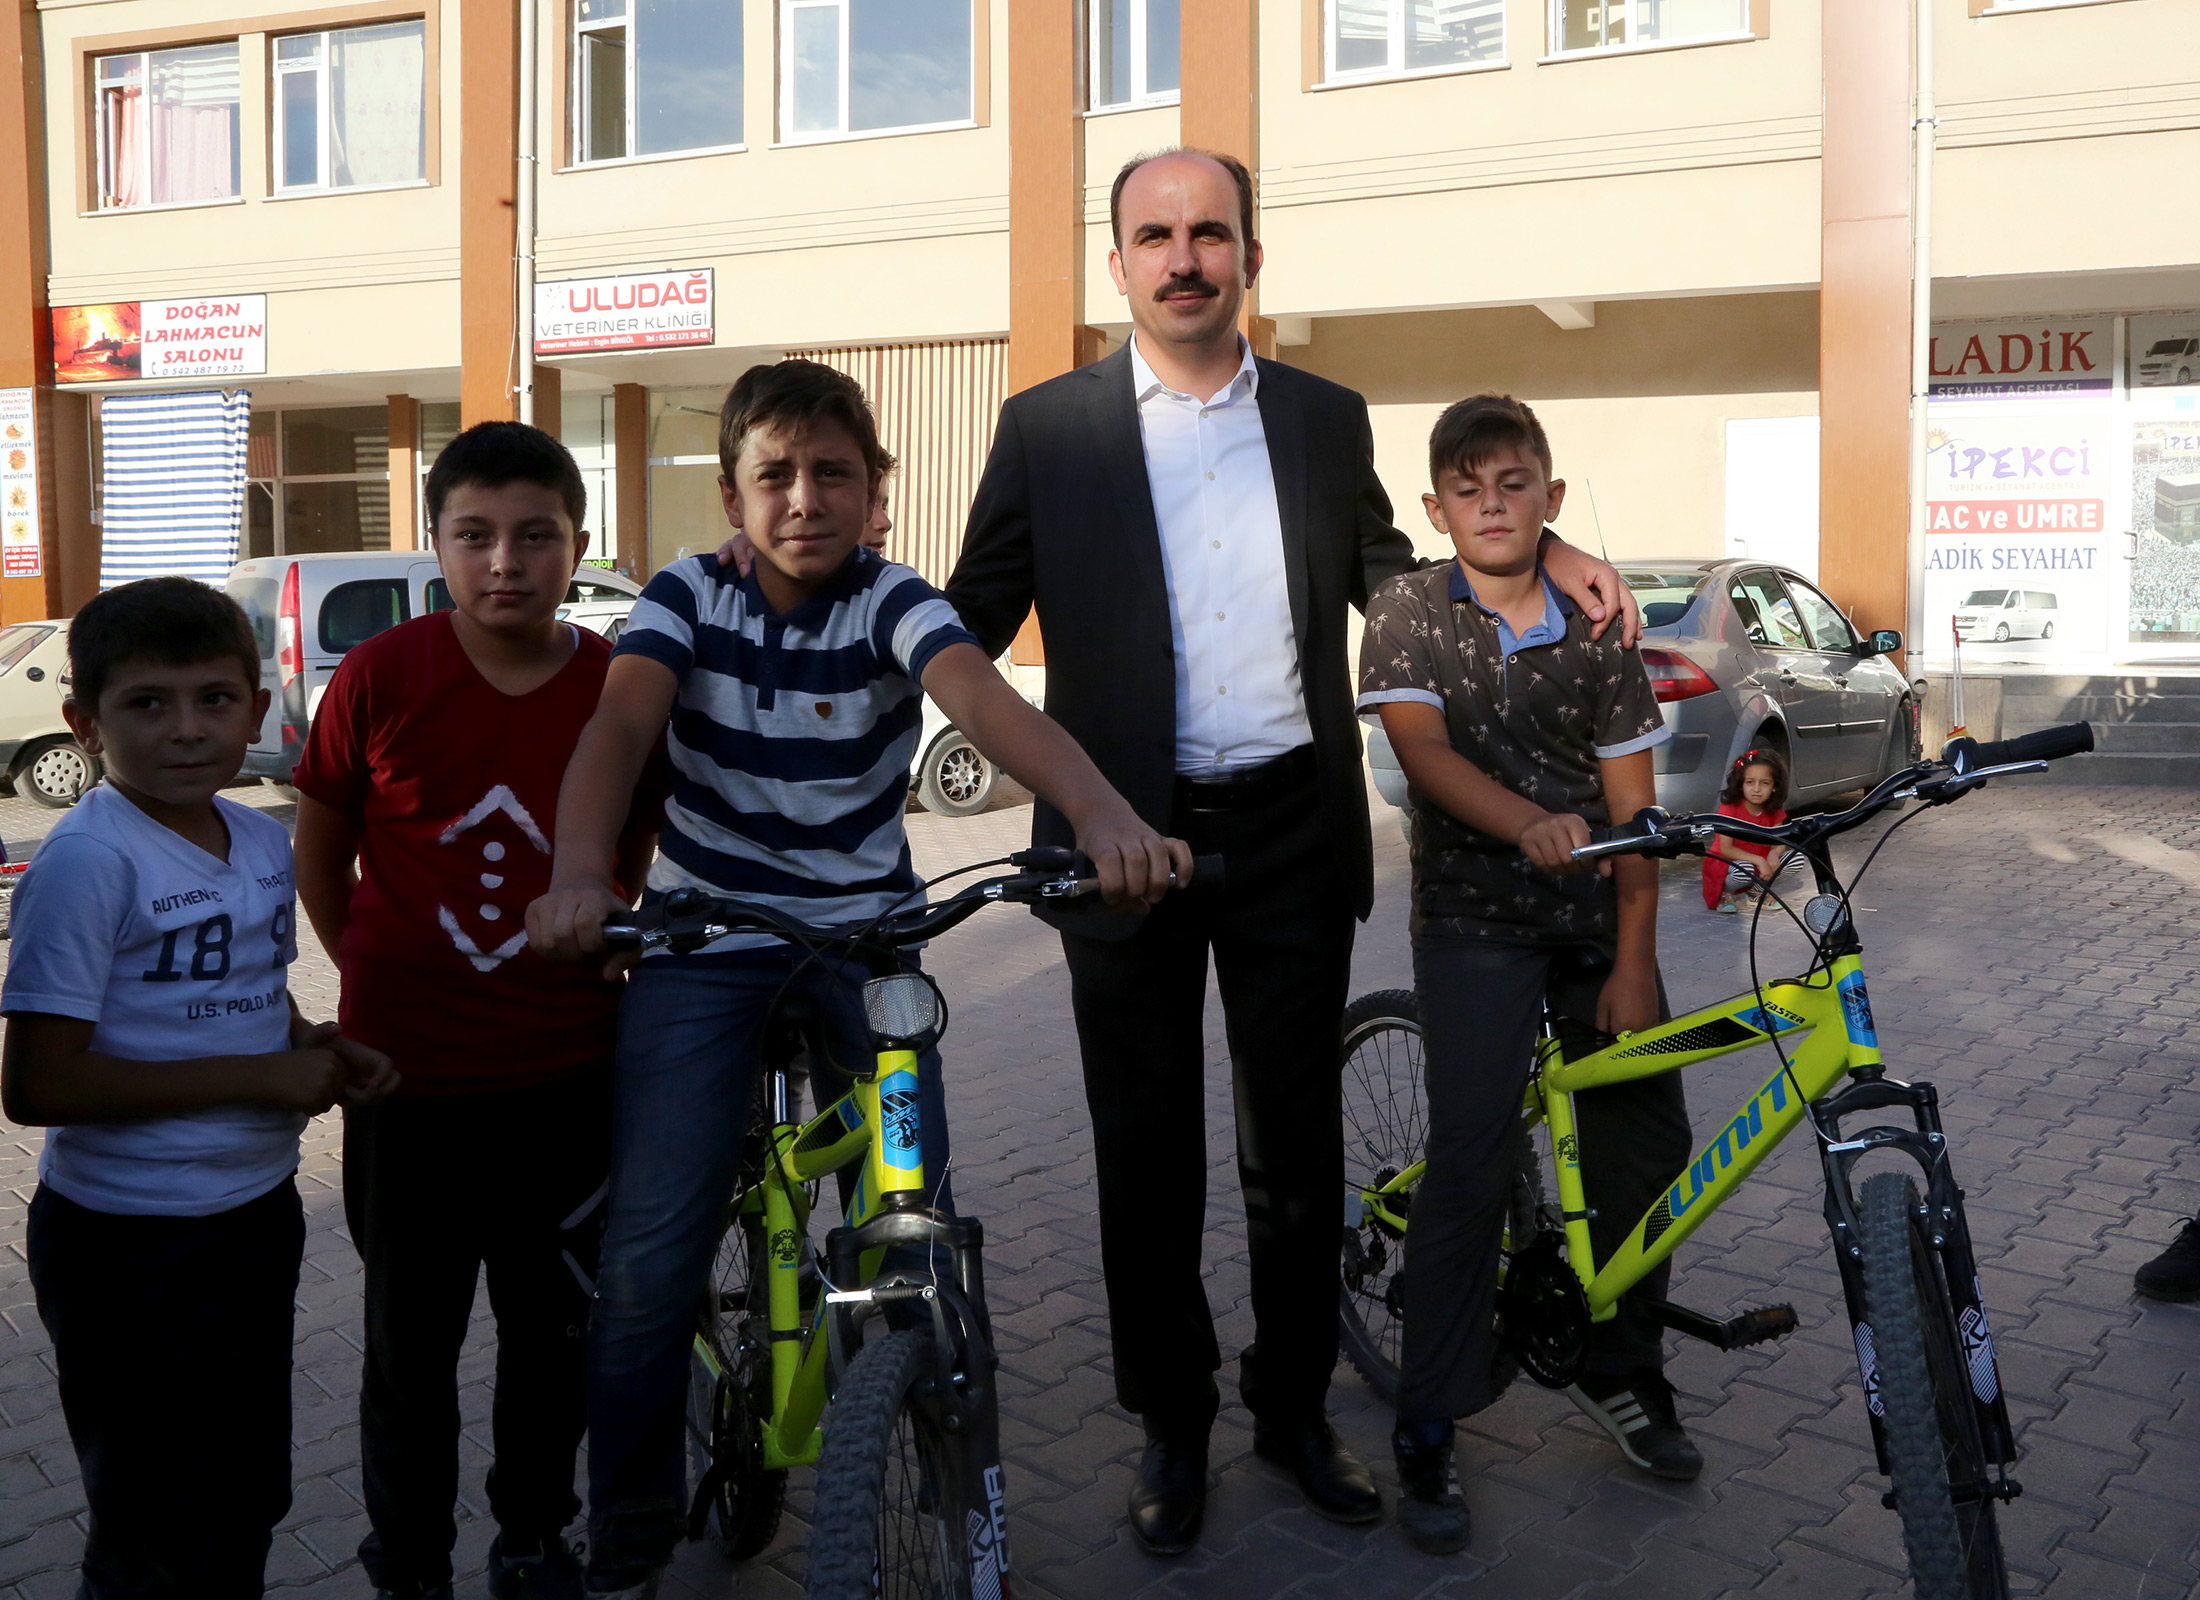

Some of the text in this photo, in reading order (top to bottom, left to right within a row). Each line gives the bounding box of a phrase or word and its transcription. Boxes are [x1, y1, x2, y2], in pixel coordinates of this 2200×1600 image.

[569, 272, 707, 313] ULUDAĞ
[165, 301, 241, 320] DOĞAN
[540, 310, 708, 337] VETERİNER KLİNİĞİ
[144, 324, 263, 343] LAHMACUN
[539, 341, 567, 350] Veteriner
[568, 339, 590, 348] Hekimi
[594, 338, 610, 347] Ergin
[645, 335, 655, 343] Tel
[659, 334, 677, 342] 0.532
[678, 333, 690, 341] 171
[690, 332, 699, 340] 36
[699, 331, 708, 339] 48
[163, 347, 244, 364] SALONU
[162, 364, 244, 376] 0 542 487 79 72
[1937, 383, 2080, 399] SEYAHAT ACENTASI
[2163, 435, 2200, 450] İPE
[3, 472, 33, 480] mevlana
[1996, 482, 2037, 491] SEYAHAT
[1977, 509, 2009, 529] ve
[2016, 503, 2098, 529] UMRE
[1991, 547, 2098, 570] SEYAHAT
[142, 913, 233, 982] 18
[187, 1003, 222, 1020] U.S.
[226, 995, 264, 1016] POLO
[1764, 1000, 1807, 1024] FASTER
[1961, 1310, 1979, 1333] 26
